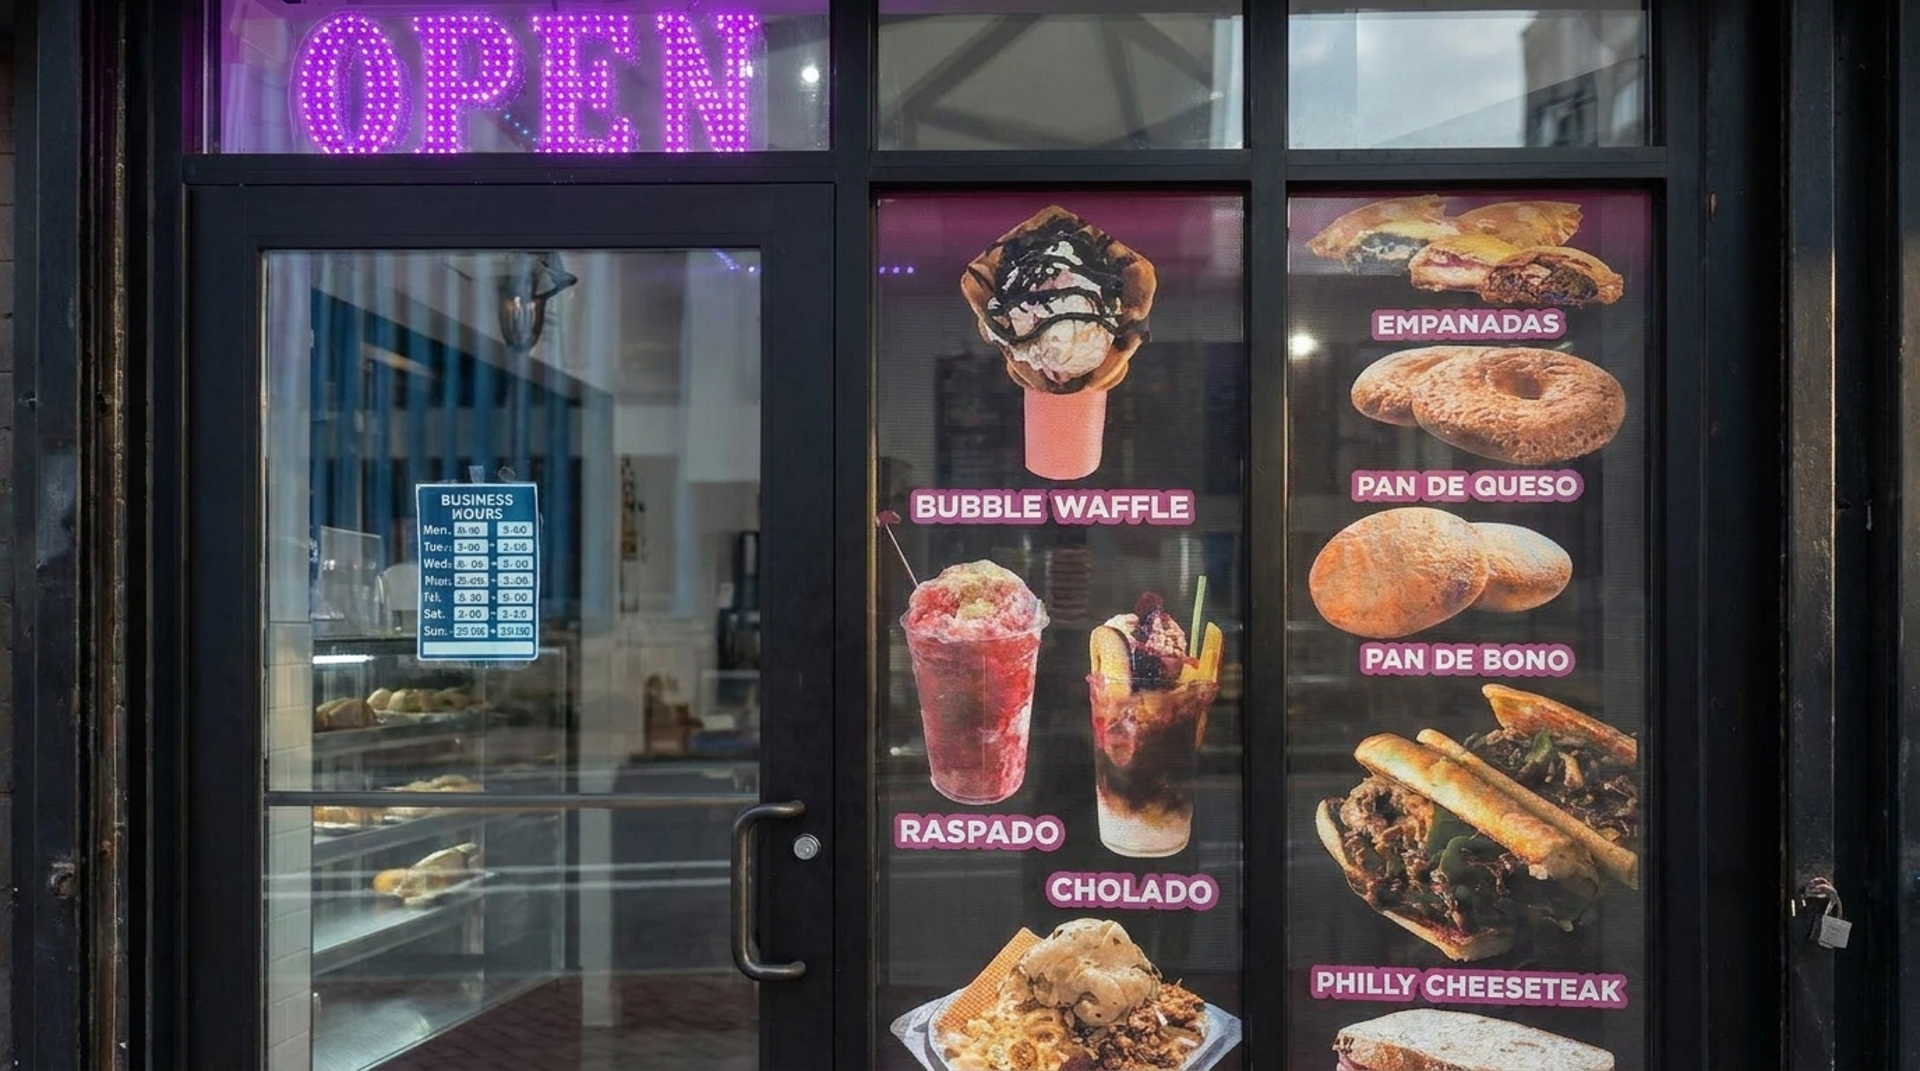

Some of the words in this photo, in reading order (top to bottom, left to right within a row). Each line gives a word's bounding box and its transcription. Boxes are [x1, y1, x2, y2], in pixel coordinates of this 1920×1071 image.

[298, 11, 757, 153] OPEN
[1378, 313, 1560, 335] EMPANADAS
[1358, 475, 1416, 496] PAN
[1427, 475, 1465, 496] DE
[1474, 475, 1578, 498] QUESO
[441, 494, 514, 506] BUSINESS
[916, 494, 1045, 519] BUBBLE
[1054, 494, 1190, 520] WAFFLE
[1366, 648, 1425, 671] PAN
[1435, 648, 1473, 671] DE
[1483, 648, 1570, 672] BONO
[899, 818, 1060, 846] RASPADO
[1050, 877, 1213, 905] CHOLADO
[1317, 970, 1418, 996] PHILLY
[1425, 973, 1621, 1003] CHEESETEAK
